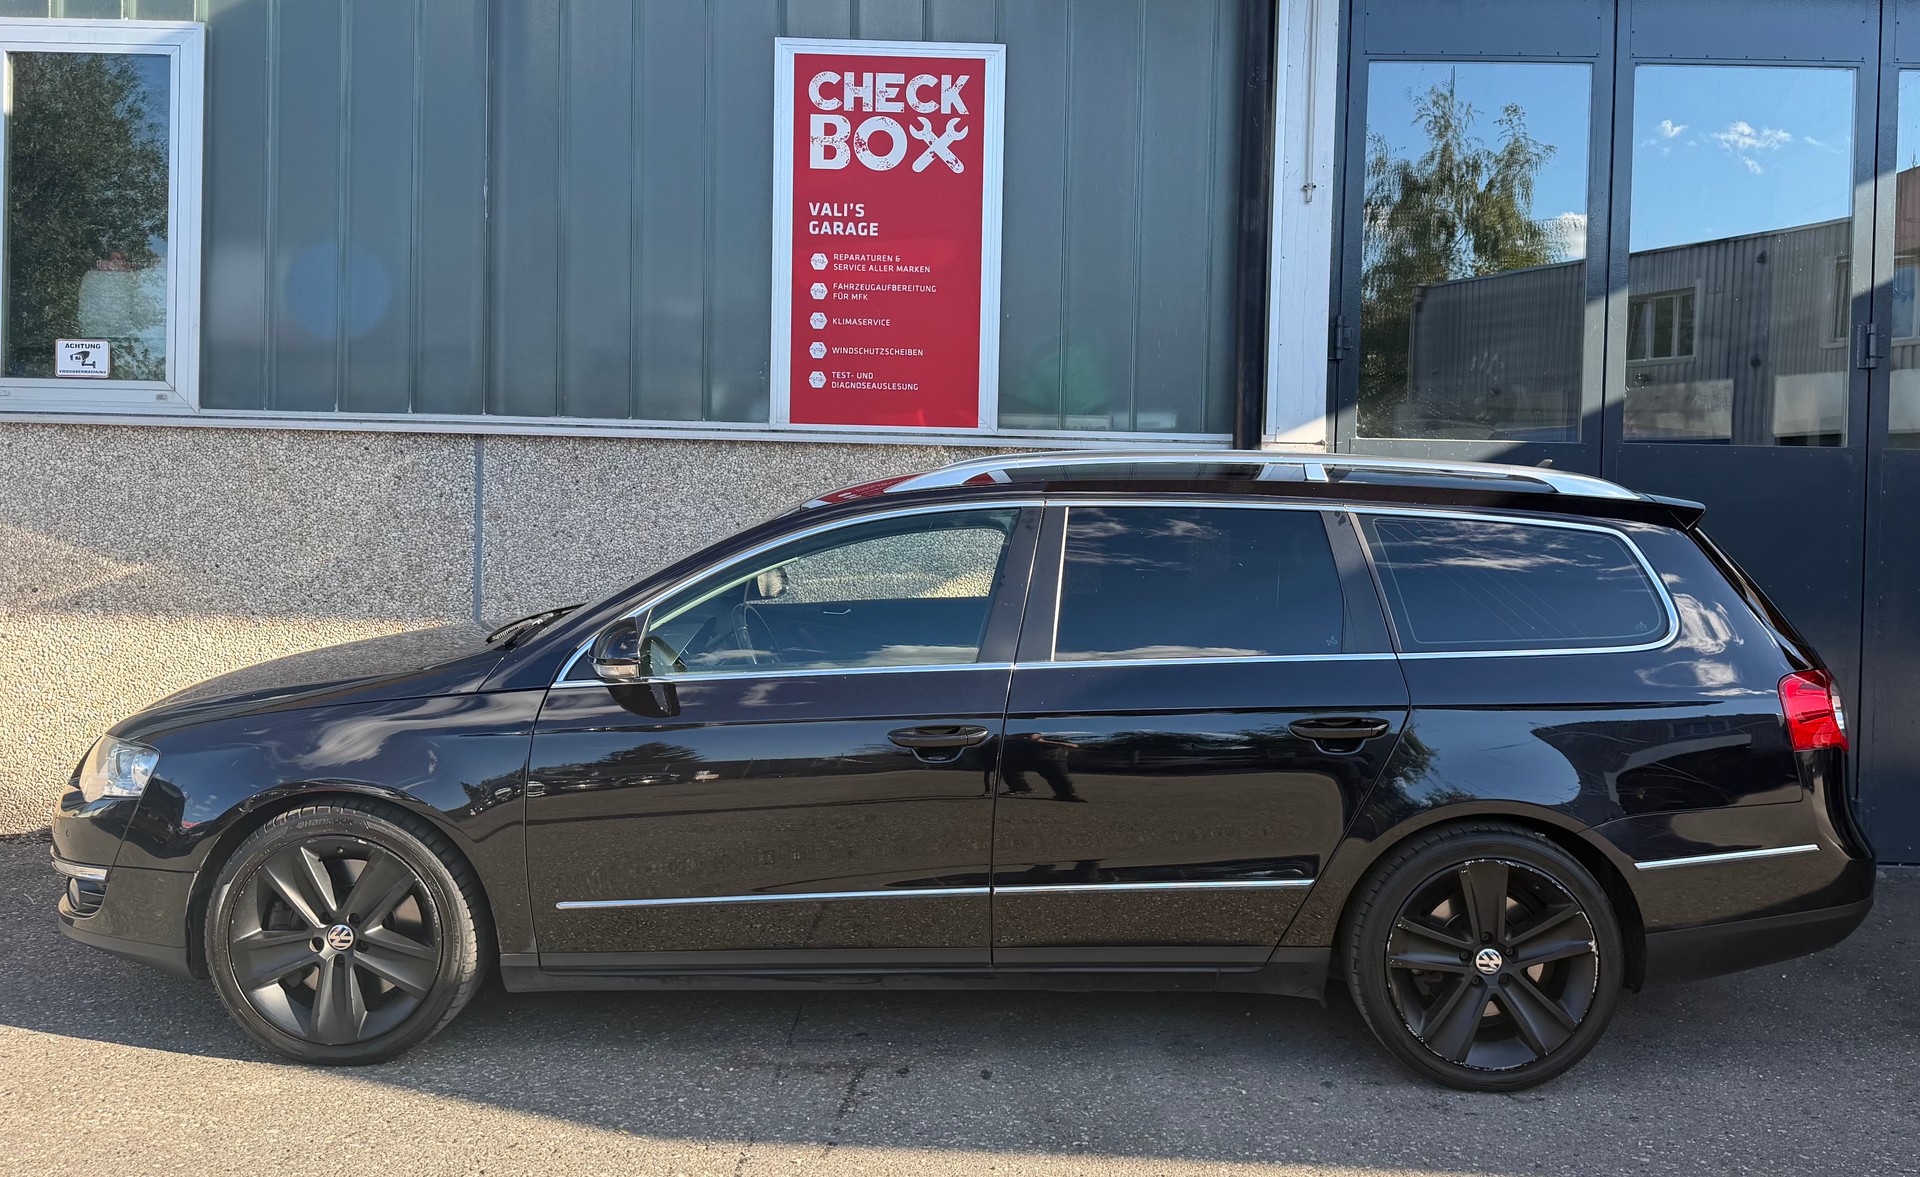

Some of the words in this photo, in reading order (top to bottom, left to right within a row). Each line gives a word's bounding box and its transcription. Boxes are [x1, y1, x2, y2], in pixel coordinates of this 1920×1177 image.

[808, 71, 970, 115] CHECK
[809, 113, 969, 174] BOX
[808, 202, 865, 217] VALI'S
[808, 221, 879, 236] GARAGE
[833, 253, 893, 262] REPARATUREN
[833, 263, 866, 272] SERVICE
[868, 264, 894, 272] ALLER
[896, 265, 931, 273] MARKEN
[832, 283, 937, 293] FAHRZEUGAUFBEREITUNG
[832, 292, 849, 300] FÜR
[832, 318, 891, 326] KLIMASERVICE
[831, 347, 924, 356] WINDSCHUTZSCHEIBEN
[831, 371, 855, 379] TEST-
[831, 382, 919, 391] DIAGNOSEAUSLESUNG
